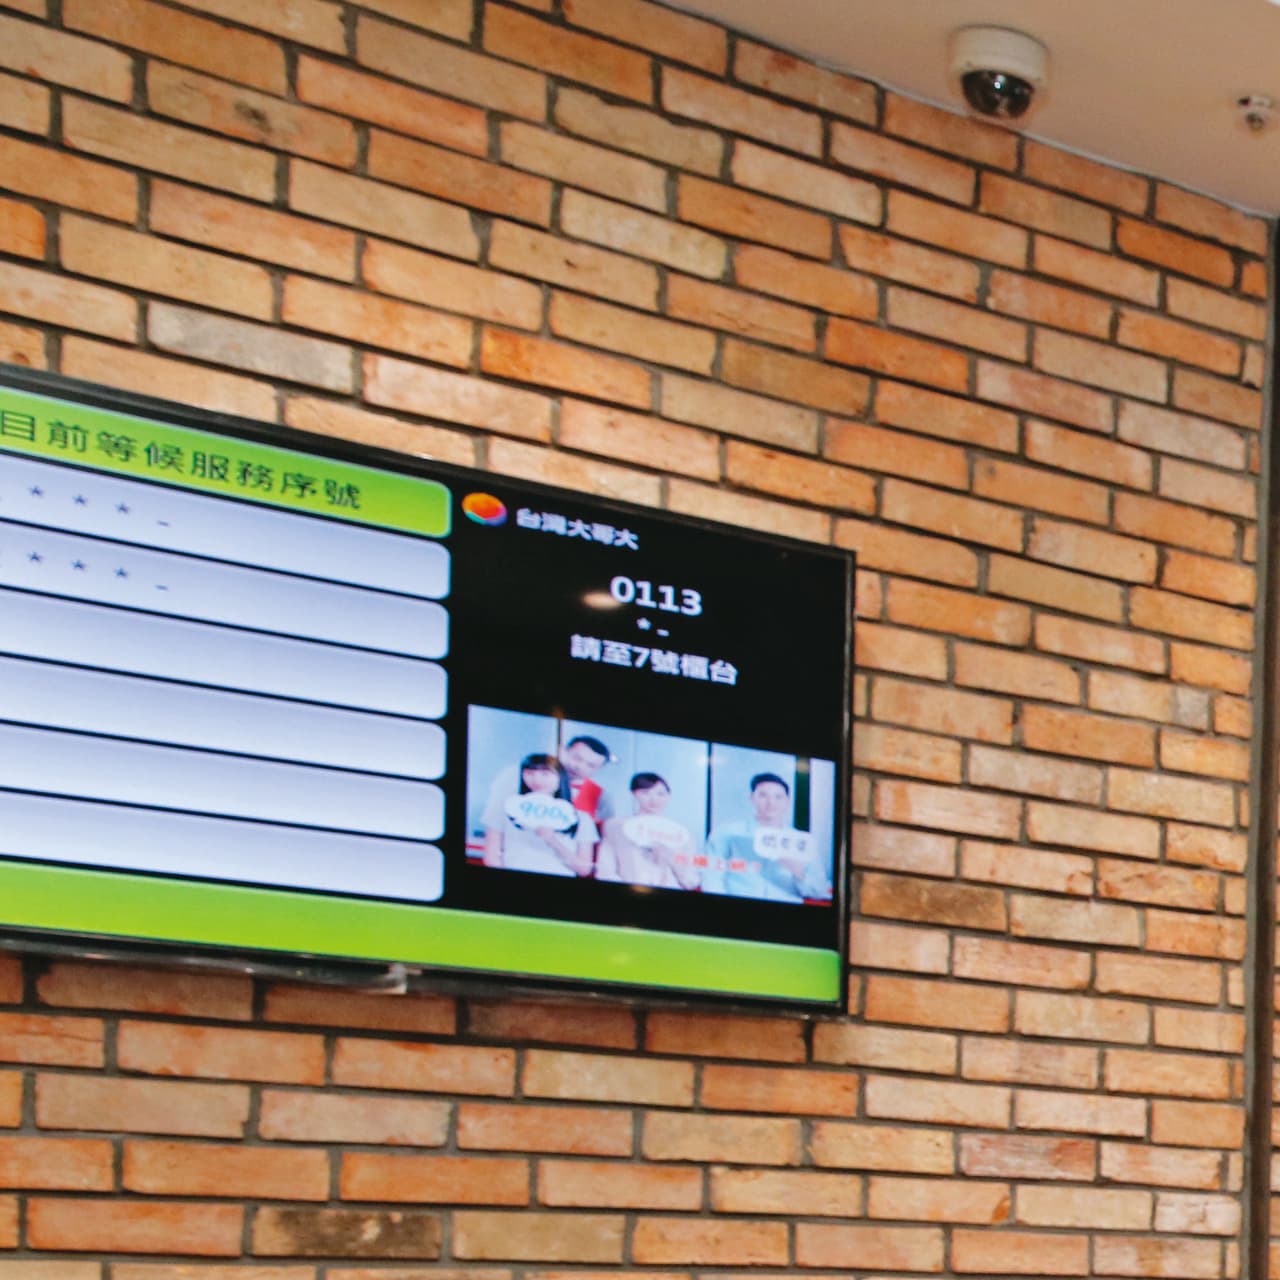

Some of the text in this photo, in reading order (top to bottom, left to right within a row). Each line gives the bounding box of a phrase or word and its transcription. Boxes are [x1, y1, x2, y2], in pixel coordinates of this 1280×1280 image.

[1, 410, 361, 509] 目前等候服務序號
[516, 508, 639, 550] 台灣大哥大
[609, 576, 703, 616] 0113
[570, 634, 738, 685] 請至7號櫃台
